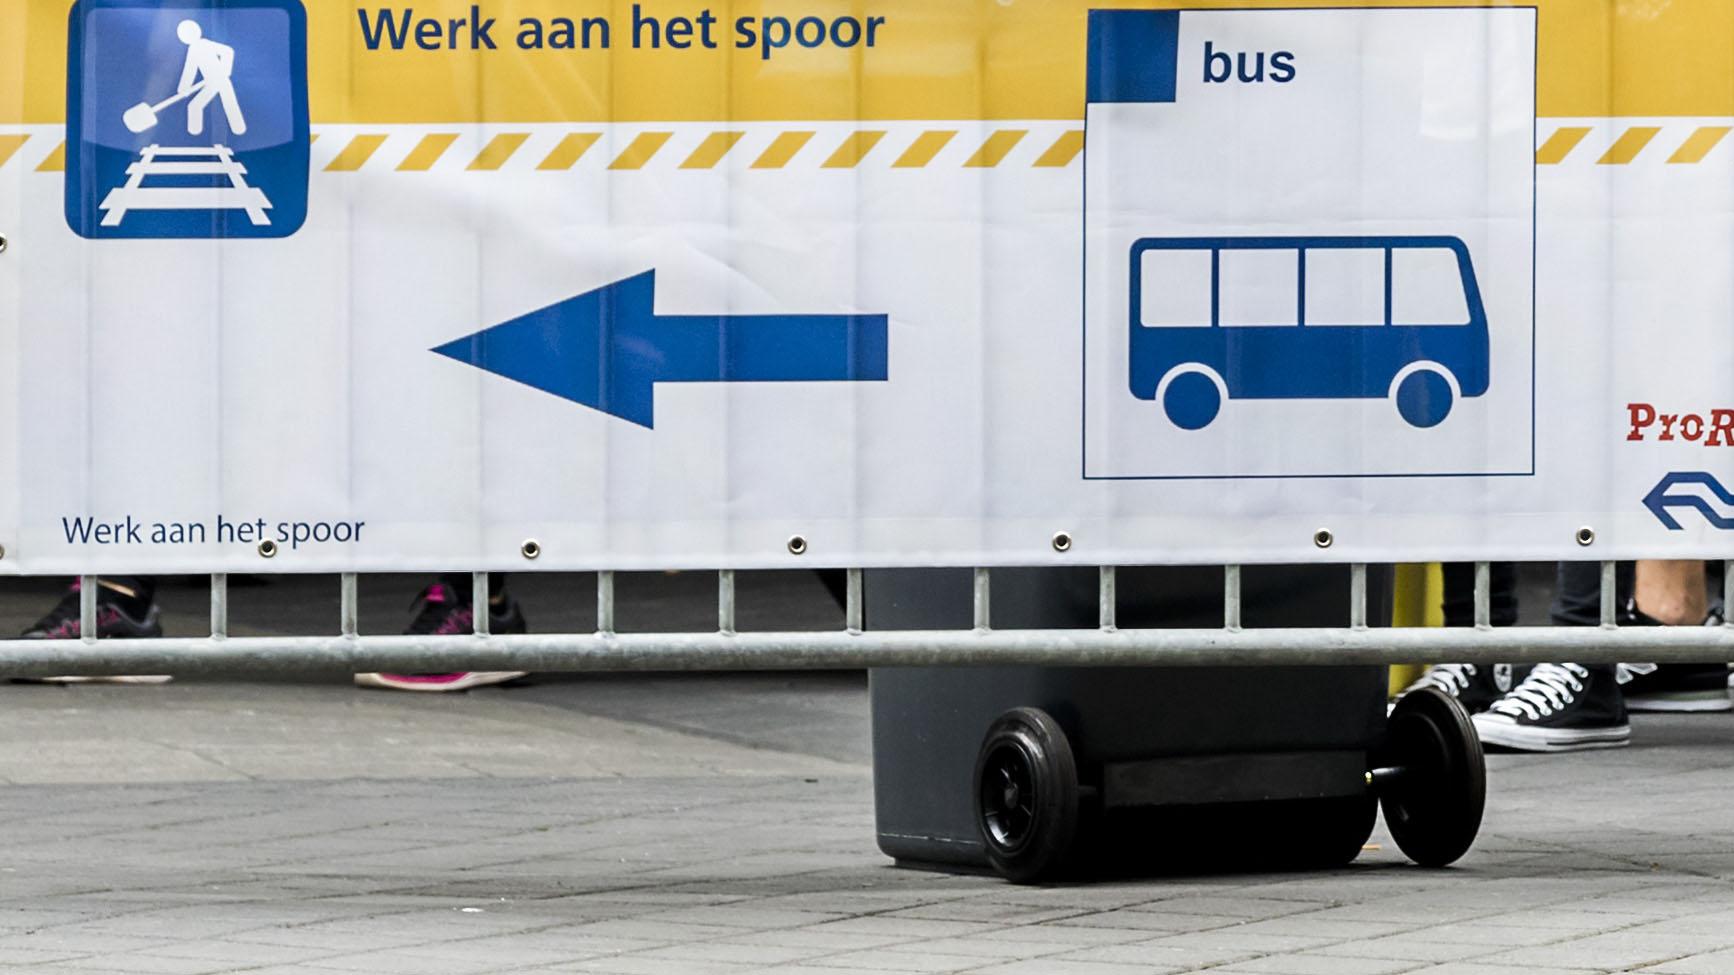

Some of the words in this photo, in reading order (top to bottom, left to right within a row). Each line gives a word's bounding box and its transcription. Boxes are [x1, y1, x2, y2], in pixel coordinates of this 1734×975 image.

[357, 5, 497, 50] Werk
[516, 16, 609, 50] aan
[632, 4, 717, 49] het
[735, 15, 886, 60] spoor
[1203, 40, 1296, 83] bus
[62, 515, 142, 544] Werk
[151, 524, 205, 544] aan
[217, 514, 267, 543] het
[277, 520, 365, 549] spoor
